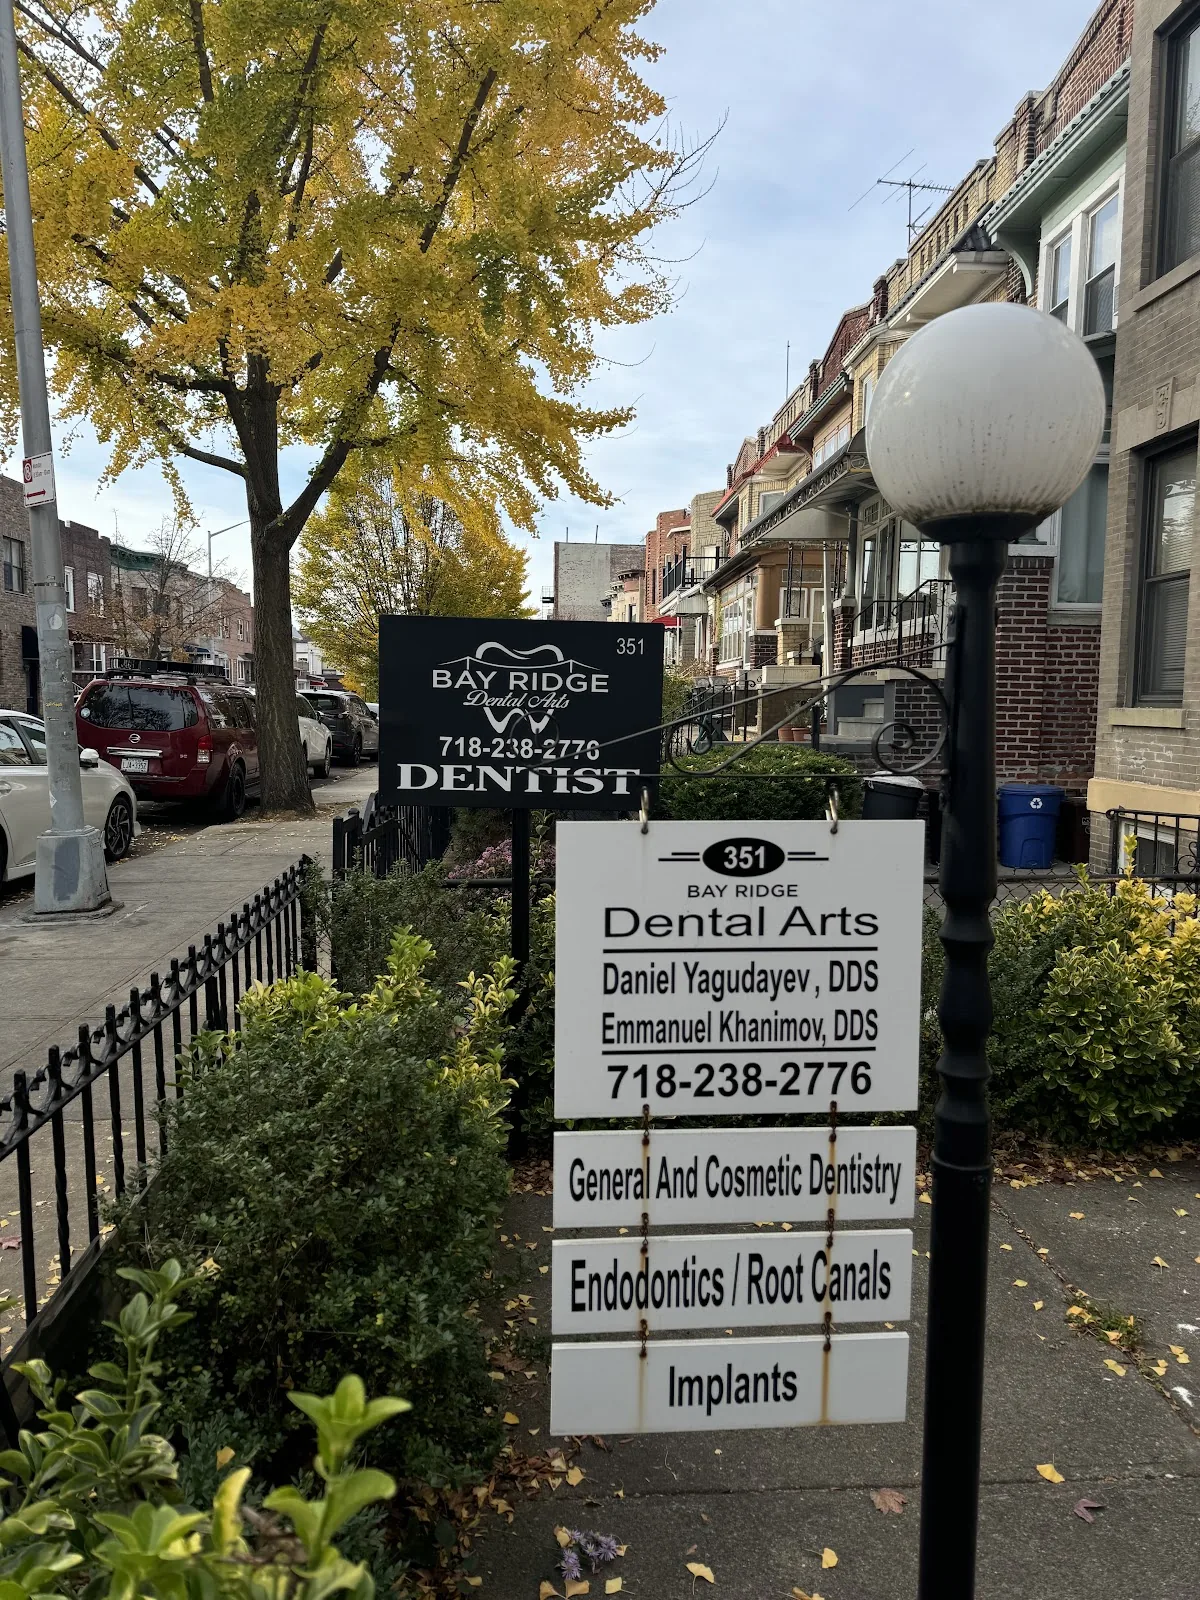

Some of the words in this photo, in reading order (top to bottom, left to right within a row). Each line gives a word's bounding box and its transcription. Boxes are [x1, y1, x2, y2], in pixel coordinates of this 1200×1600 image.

[616, 637, 644, 655] 351
[432, 670, 498, 690] BAY
[509, 671, 609, 693] RIDGE
[463, 689, 528, 707] Dental
[527, 692, 570, 708] Arts
[439, 736, 600, 760] 718-238-2776
[396, 763, 641, 795] DENTIST
[723, 845, 766, 869] 351
[687, 884, 728, 898] BAY
[735, 884, 798, 898] RIDGE
[604, 906, 765, 938] Dental
[778, 905, 879, 937] Arts
[603, 962, 676, 995] Daniel
[828, 959, 879, 993] DDS
[602, 1011, 712, 1045] Emmanuel
[719, 1009, 828, 1047] Khanimov,
[834, 1008, 878, 1042] DDS
[607, 1060, 872, 1099] 718-238-2776
[569, 1156, 651, 1202] General
[655, 1155, 698, 1199] And
[705, 1153, 803, 1199] Cosmetic
[809, 1152, 902, 1205] Dentistry
[571, 1254, 725, 1312] Endodontics
[747, 1252, 804, 1305] Root
[811, 1248, 891, 1303] Canals
[668, 1362, 798, 1417] Implants
